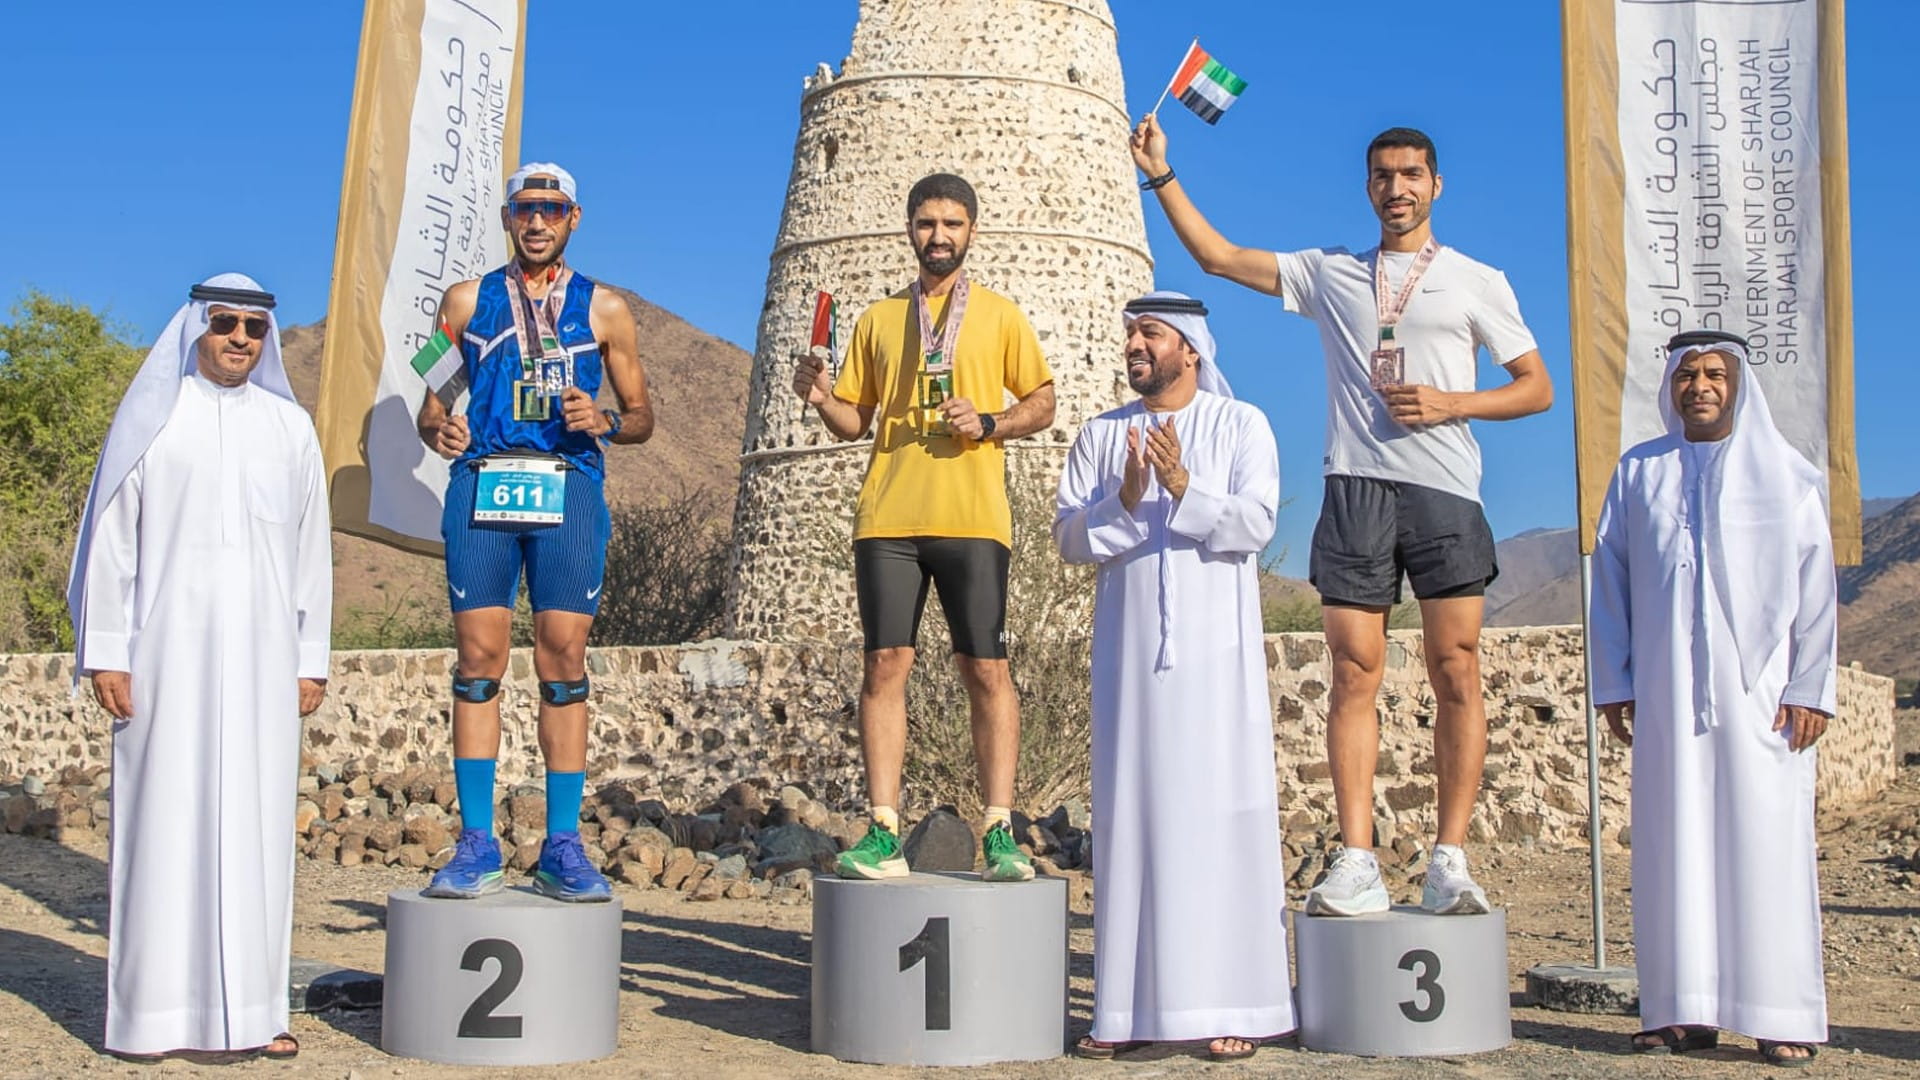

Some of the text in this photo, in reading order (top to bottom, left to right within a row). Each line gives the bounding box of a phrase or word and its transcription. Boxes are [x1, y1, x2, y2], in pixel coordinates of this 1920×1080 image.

[433, 37, 467, 185] حكومة
[1641, 38, 1688, 193] حكومة
[1690, 37, 1730, 331] مجلس الشارقة الرياض
[1738, 39, 1769, 366] GOVERNMENT OF SHARJAH
[1768, 37, 1798, 364] SHARJAH SPORTS COUNCIL
[493, 484, 544, 508] 611
[456, 937, 524, 1038] 2
[899, 916, 951, 1031] 1
[1397, 948, 1446, 1023] 3
